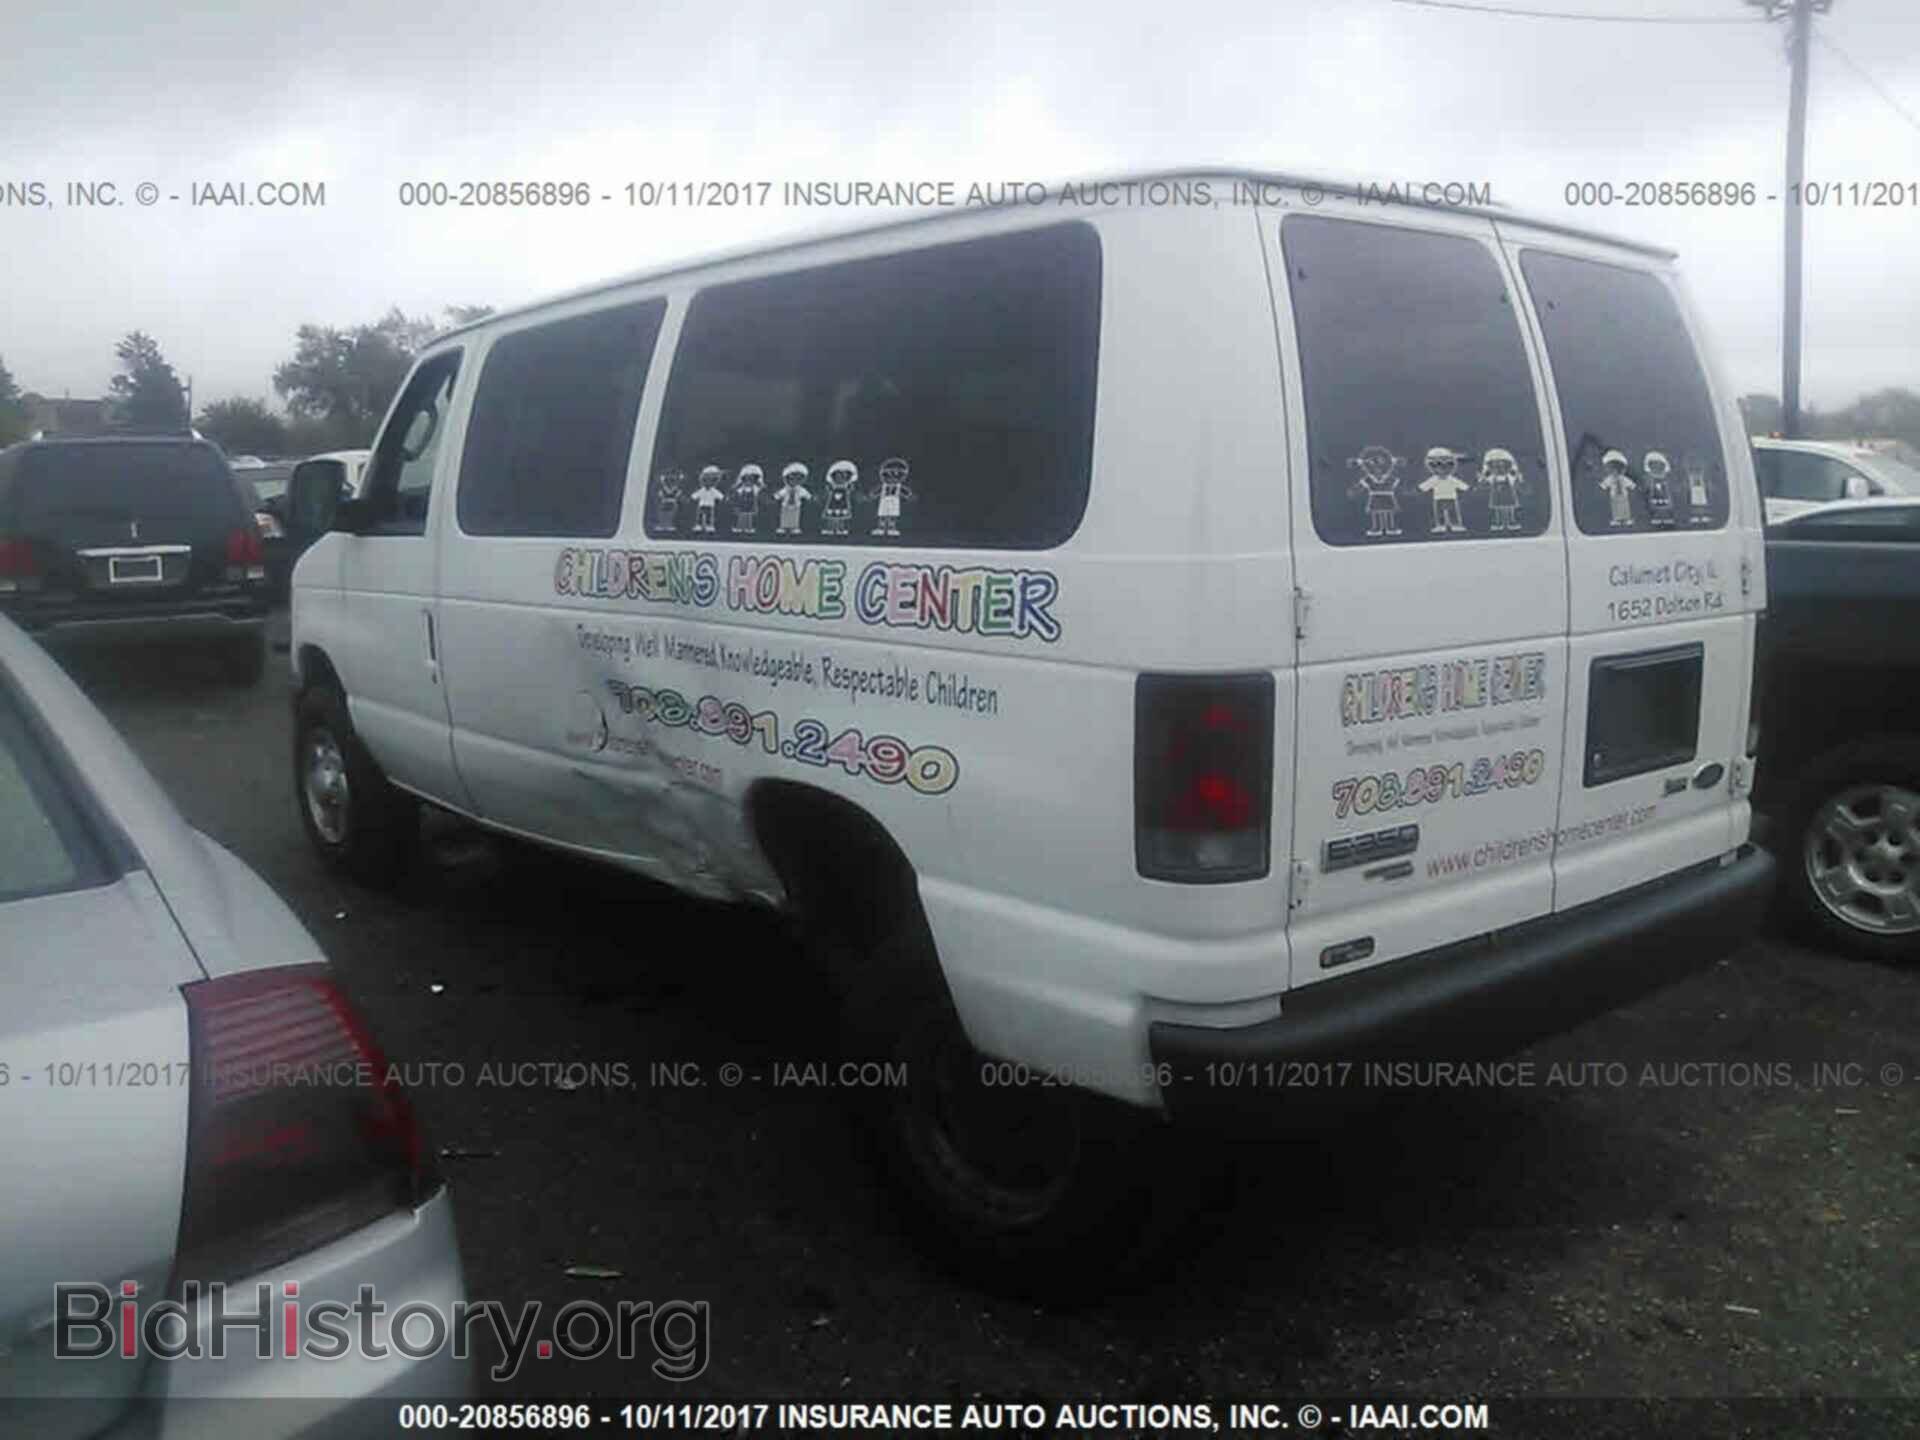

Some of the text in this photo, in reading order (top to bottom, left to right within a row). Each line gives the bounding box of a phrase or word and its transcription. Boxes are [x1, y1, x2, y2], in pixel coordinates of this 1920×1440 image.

[727, 555, 846, 618] HOME
[856, 561, 1061, 643] CENTER
[1608, 600, 1652, 622] 1652
[822, 656, 919, 705] Respectable
[925, 670, 998, 716] Children
